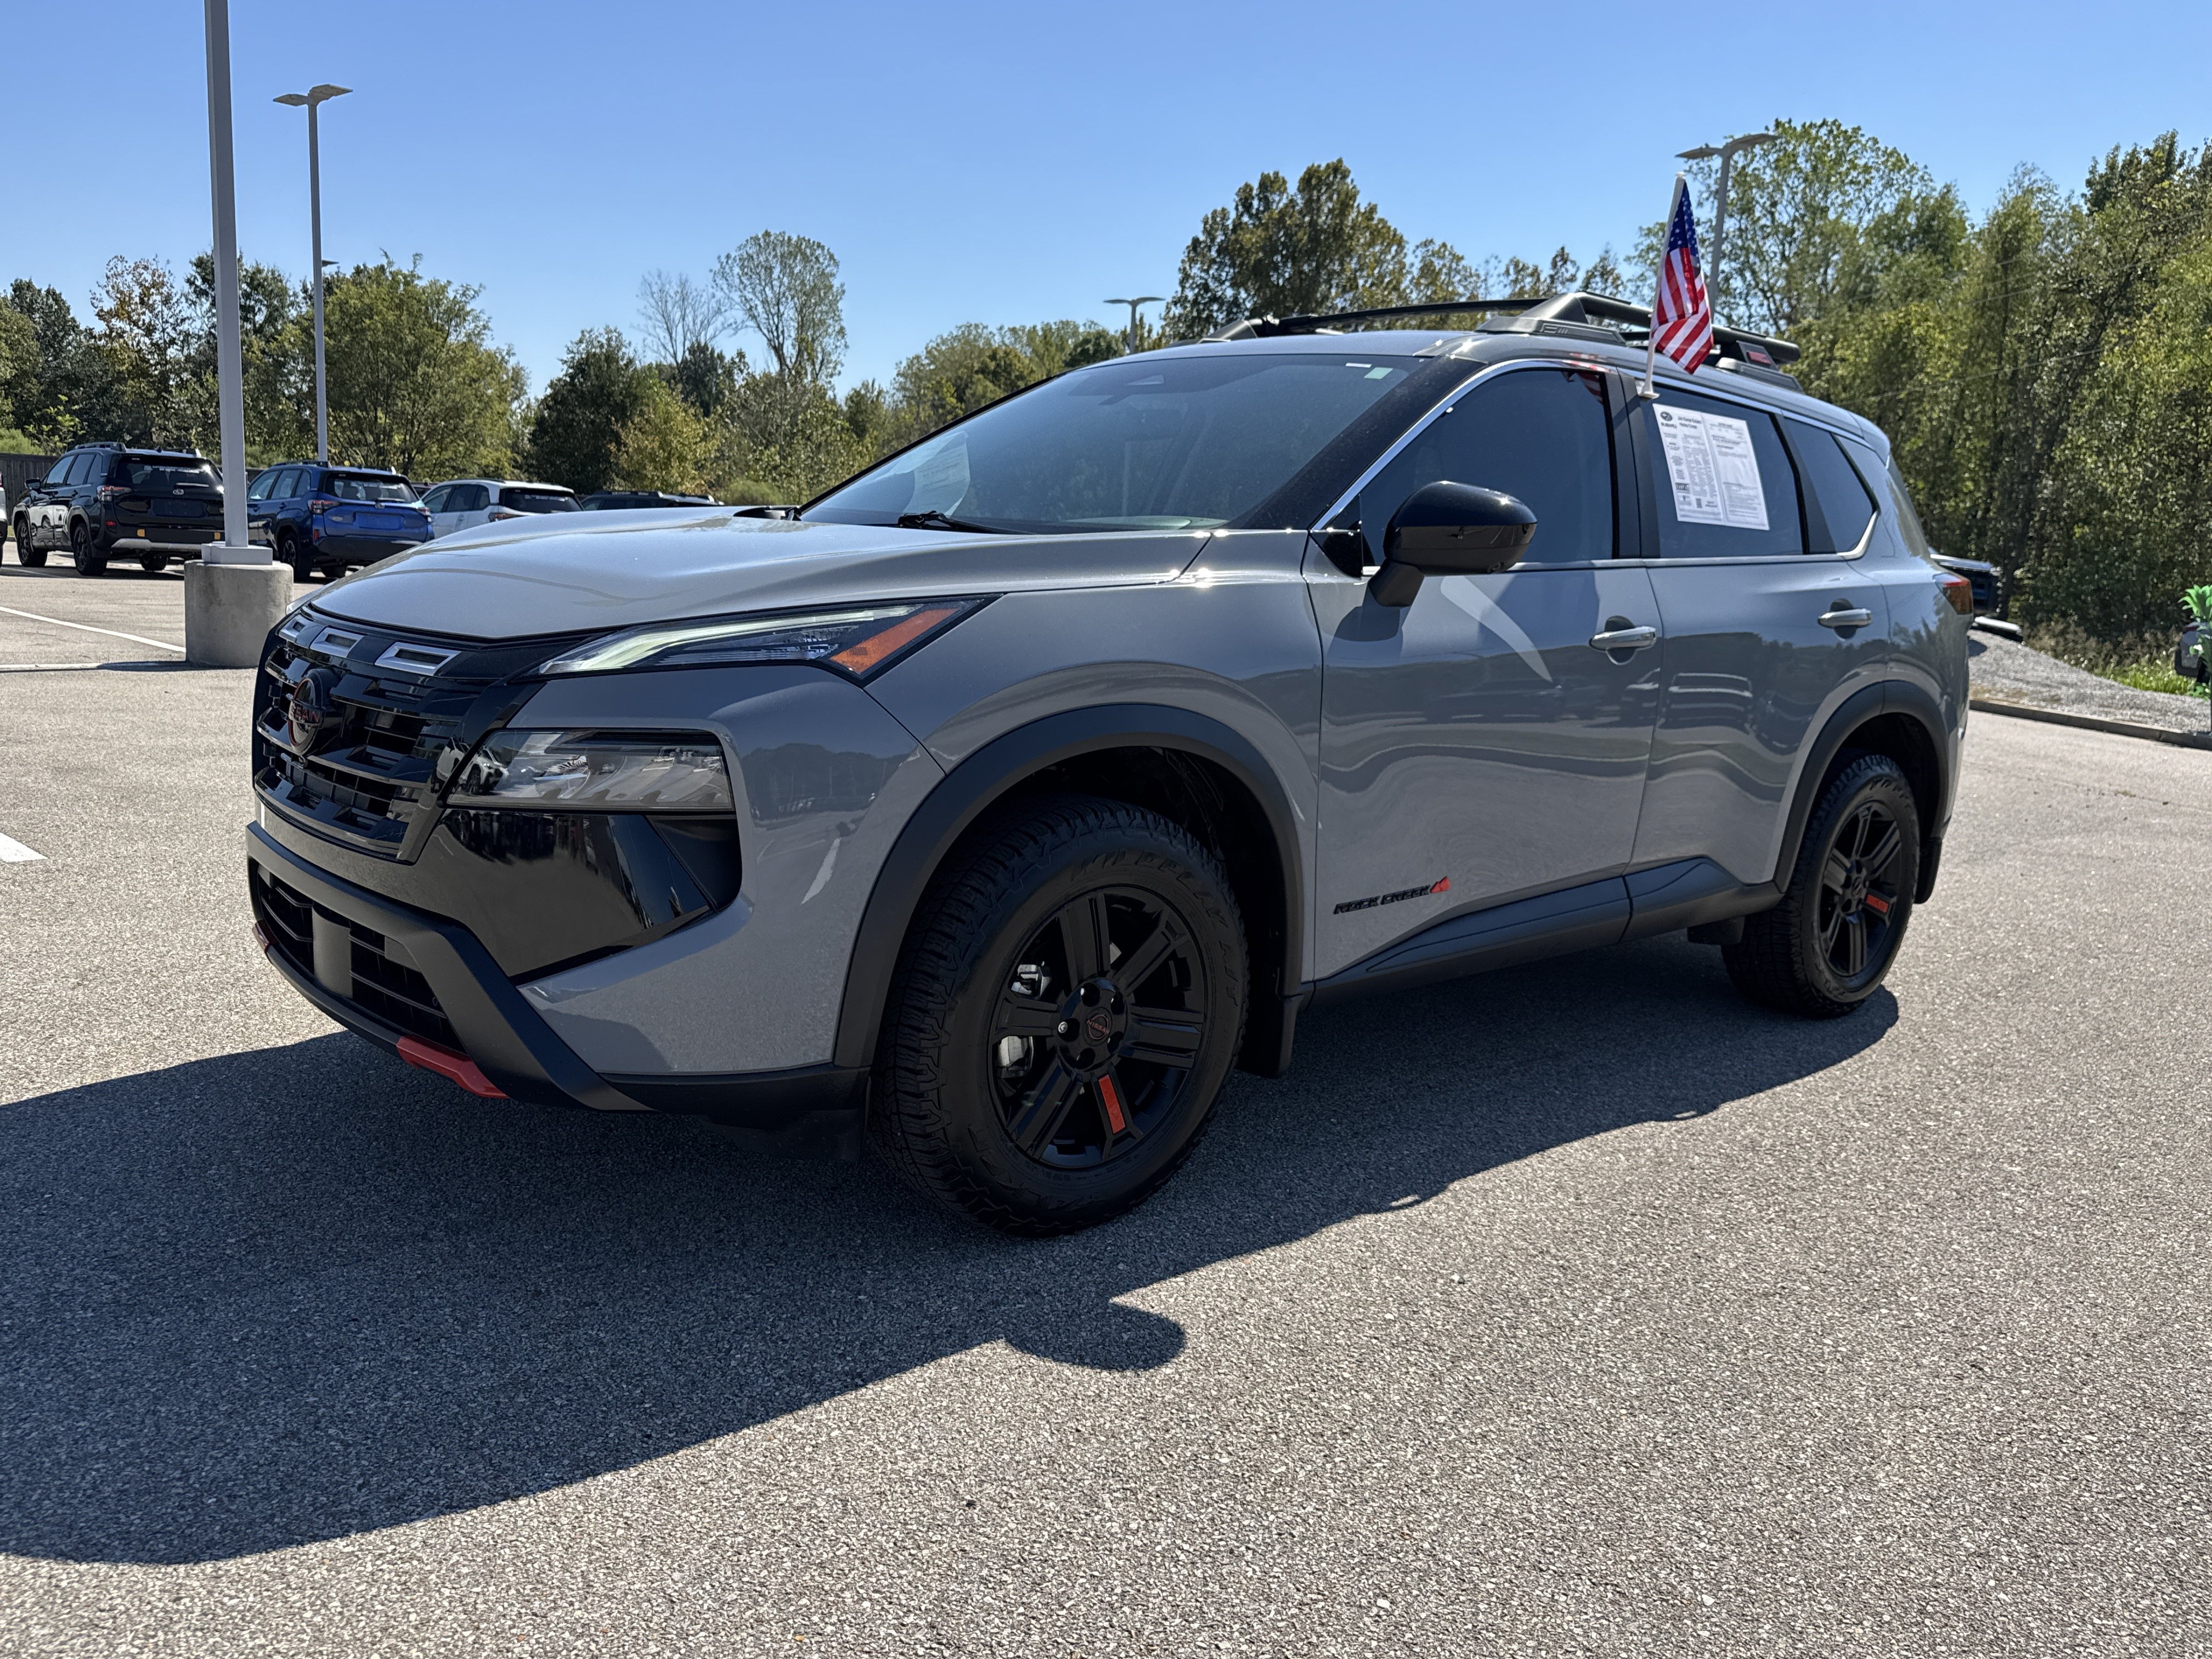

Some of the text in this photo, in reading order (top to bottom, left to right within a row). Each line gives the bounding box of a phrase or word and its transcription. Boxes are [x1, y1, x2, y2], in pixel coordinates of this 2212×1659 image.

[1333, 884, 1431, 915] ROCK CREEK
[1086, 1018, 1110, 1035] NISSAN
